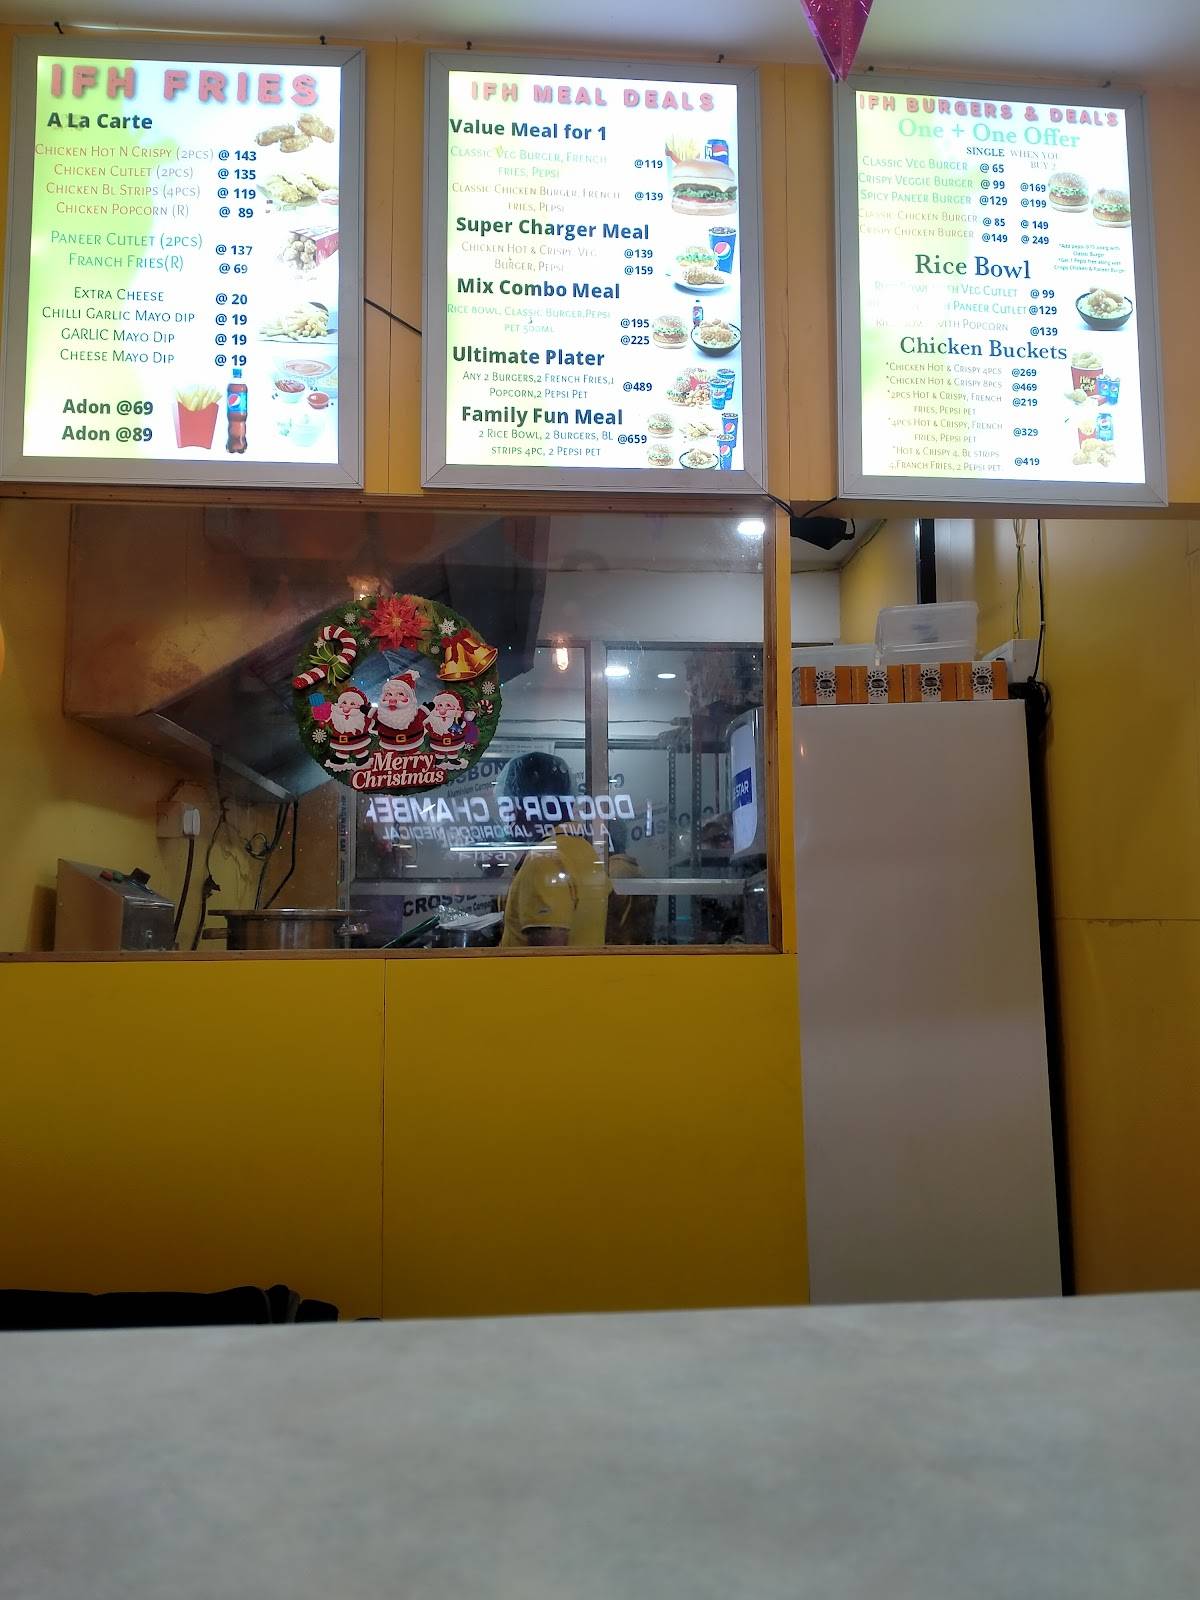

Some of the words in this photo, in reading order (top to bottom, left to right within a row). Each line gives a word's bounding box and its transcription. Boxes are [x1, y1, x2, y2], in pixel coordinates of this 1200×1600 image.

[50, 63, 136, 99] IFH
[164, 69, 319, 107] FRIES
[471, 80, 519, 102] IFH
[533, 85, 608, 107] MEAL
[623, 88, 715, 112] DEALS
[859, 94, 896, 112] IFH
[906, 97, 1014, 121] BURGERS
[1023, 105, 1039, 122] &
[1049, 107, 1119, 128] DEAL'S
[47, 112, 62, 128] A
[67, 112, 90, 129] La
[97, 113, 153, 130] Carte
[450, 118, 505, 136] Value
[511, 122, 558, 139] Meal
[564, 124, 593, 141] for
[597, 126, 607, 141] 1
[898, 118, 944, 139] One
[952, 123, 965, 139] +
[973, 123, 1017, 144] One
[1024, 126, 1081, 149] Offer
[35, 143, 87, 157] CHICKEN
[91, 146, 114, 157] HOT
[119, 146, 128, 157] N
[131, 146, 172, 159] CRISPY
[234, 150, 257, 162] 143
[966, 146, 1005, 158] SINGLE
[54, 163, 106, 177] CHICKEN
[110, 165, 153, 177] CUTLET
[156, 165, 193, 179] (2PCS)
[234, 168, 257, 180] 135
[634, 159, 664, 169] @119
[862, 155, 903, 168] CLASSIC
[928, 158, 968, 171] BURGER
[992, 164, 1005, 174] 65
[46, 182, 98, 195] CHICKEN
[119, 184, 159, 197] STRIPS
[234, 188, 257, 200] 119
[858, 172, 892, 185] CRISPY
[934, 175, 974, 188] BURGER
[992, 179, 1006, 190] 99
[1020, 182, 1047, 193] @169
[634, 191, 664, 201] @139
[932, 192, 972, 205] BURGER
[979, 195, 1008, 206] @129
[1020, 198, 1047, 209] @199
[56, 201, 108, 215] CHICKEN
[112, 203, 168, 217] POPCORN
[172, 204, 190, 218] (R)
[238, 207, 254, 219] 89
[456, 216, 513, 237] Super
[518, 219, 597, 241] Charger
[602, 223, 649, 240] Meal
[994, 217, 1006, 227] 85
[1032, 220, 1049, 230] 149
[51, 230, 102, 246] PANEER
[106, 232, 155, 247] CUTLET
[160, 232, 203, 250] (2PCS)
[231, 244, 253, 256] 137
[981, 232, 1009, 243] @149
[1032, 235, 1050, 245] 249
[69, 252, 123, 268] FRANCH
[127, 254, 185, 272] FRIES(R)
[233, 263, 248, 274] 69
[624, 249, 654, 259] @139
[624, 265, 654, 276] @159
[915, 253, 968, 275] Rice
[974, 255, 1032, 280] Bowl
[74, 287, 113, 301] EXTRA
[116, 288, 165, 302] CHEESE
[231, 294, 248, 306] 20
[457, 277, 494, 294] Mix
[499, 279, 567, 297] Combo
[572, 282, 621, 299] Meal
[1042, 289, 1055, 299] 99
[42, 306, 81, 320] CHILLI
[86, 307, 131, 321] GARLIC
[135, 309, 171, 323] MAYO
[175, 312, 195, 323] DIP
[231, 314, 248, 326] 19
[1028, 305, 1058, 316] @129
[620, 318, 650, 329] @195
[962, 319, 1009, 332] POPCORN
[1030, 326, 1059, 337] @139
[61, 328, 109, 341] GARLIC
[113, 329, 149, 342] MAYO
[153, 331, 176, 344] DIP
[231, 334, 248, 346] 19
[620, 335, 650, 346] @225
[60, 348, 108, 362] CHEESE
[112, 350, 149, 363] MAYO
[152, 351, 175, 364] DIP
[231, 354, 247, 366] 19
[452, 345, 540, 365] Ultimate
[545, 348, 605, 366] Plater
[900, 336, 983, 356] Chicken
[988, 339, 1068, 360] Buckets
[927, 362, 944, 372] HOT
[1011, 368, 1037, 378] @269
[462, 370, 482, 381] ANY
[545, 373, 580, 384] FRENCH
[623, 381, 653, 393] @489
[927, 376, 944, 386] HOT
[1011, 382, 1038, 393] @469
[544, 388, 570, 399] PEPSI
[572, 389, 588, 399] PET
[912, 388, 930, 399] HOT
[1012, 397, 1038, 408] @219
[62, 399, 111, 415] Adon
[116, 400, 154, 416] @69
[462, 405, 528, 427] Family
[533, 407, 569, 425] Fun
[574, 408, 623, 425] Meal
[61, 425, 110, 442] Adon
[115, 427, 153, 443] @89
[487, 428, 508, 439] RICE
[617, 434, 648, 445] @659
[1013, 427, 1039, 437] @329
[491, 446, 522, 456] STRIPS
[556, 446, 583, 456] PEPSI
[585, 447, 601, 457] PET
[1014, 457, 1040, 467] @419
[373, 751, 434, 774] Merry
[352, 769, 444, 789] Christmas
